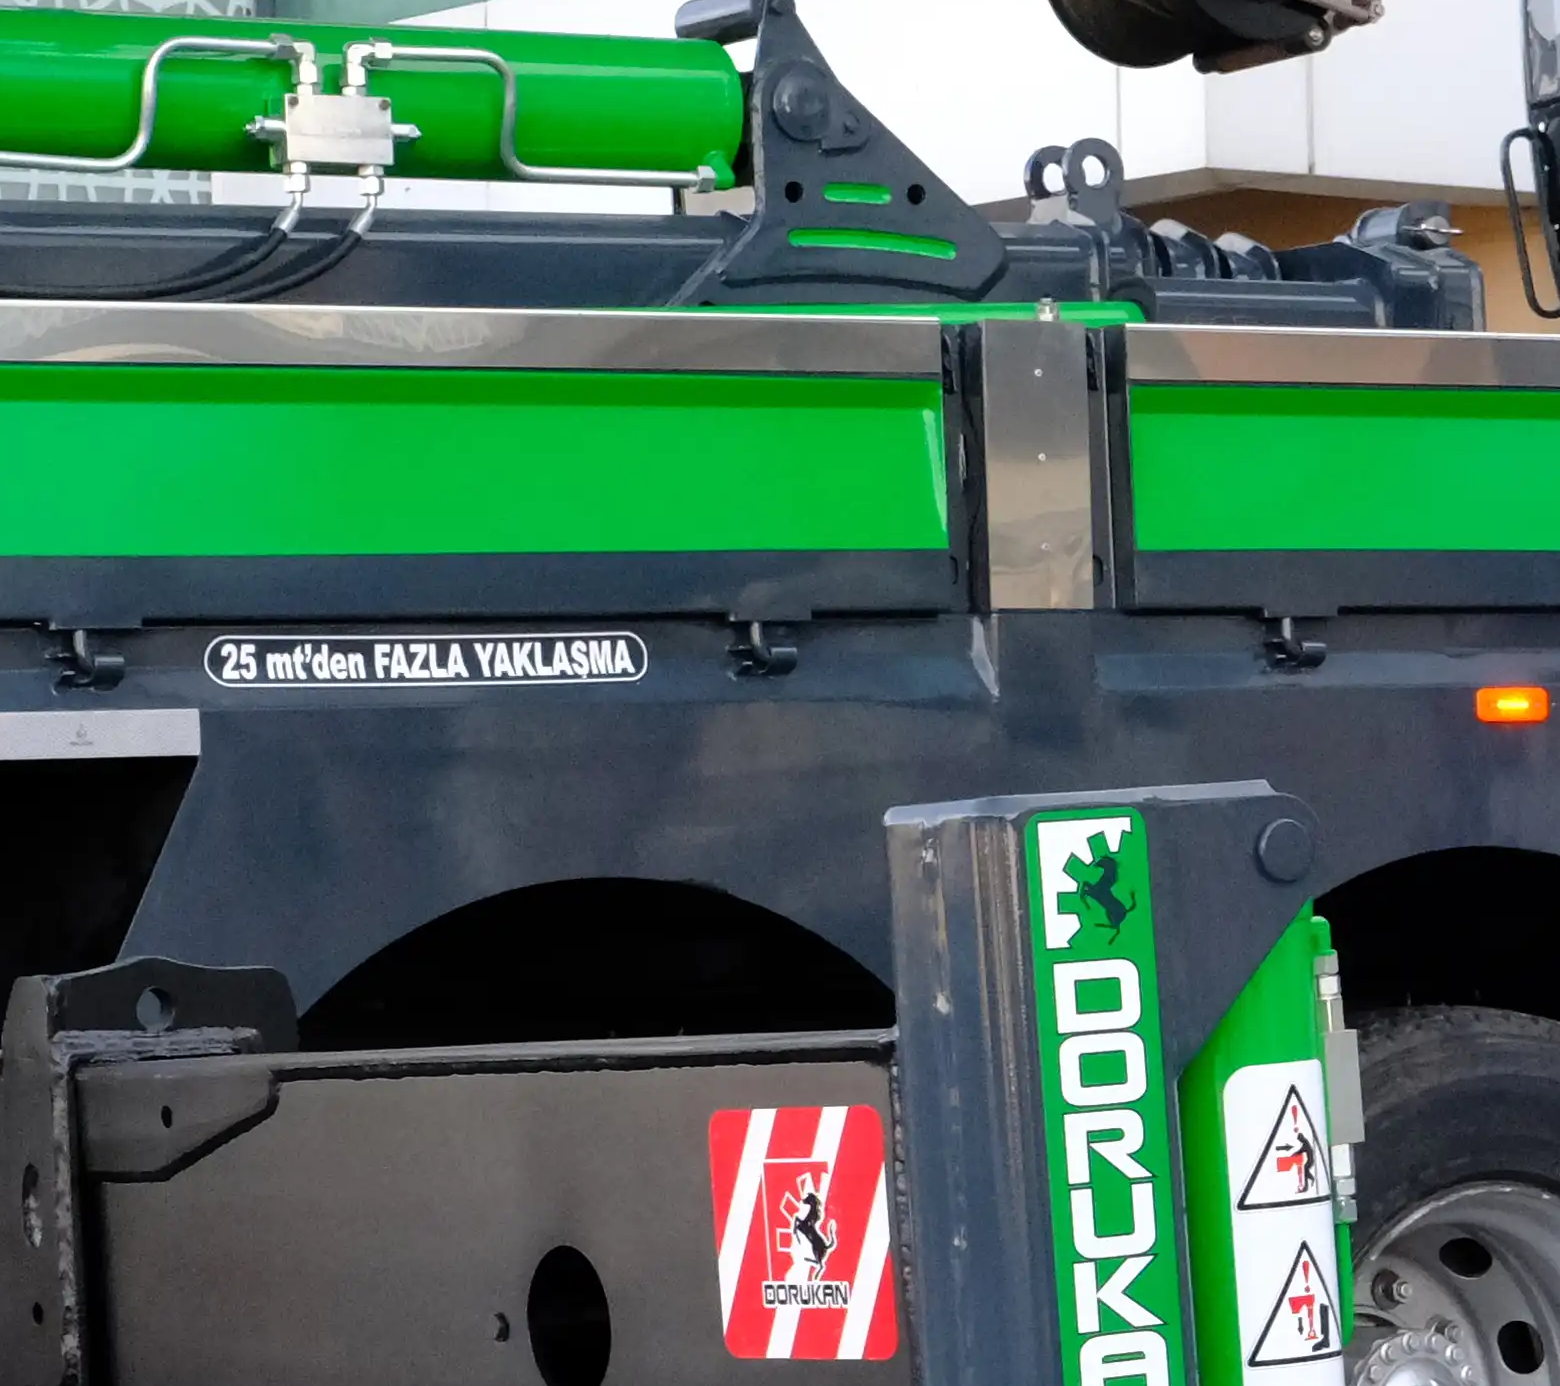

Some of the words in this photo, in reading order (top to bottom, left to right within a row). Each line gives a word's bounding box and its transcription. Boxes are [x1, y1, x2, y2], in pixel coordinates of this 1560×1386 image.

[221, 644, 257, 680] 25
[374, 643, 469, 679] FAZLA
[474, 639, 636, 679] YAKLAŞMA
[764, 1284, 848, 1305] DORUKAN
